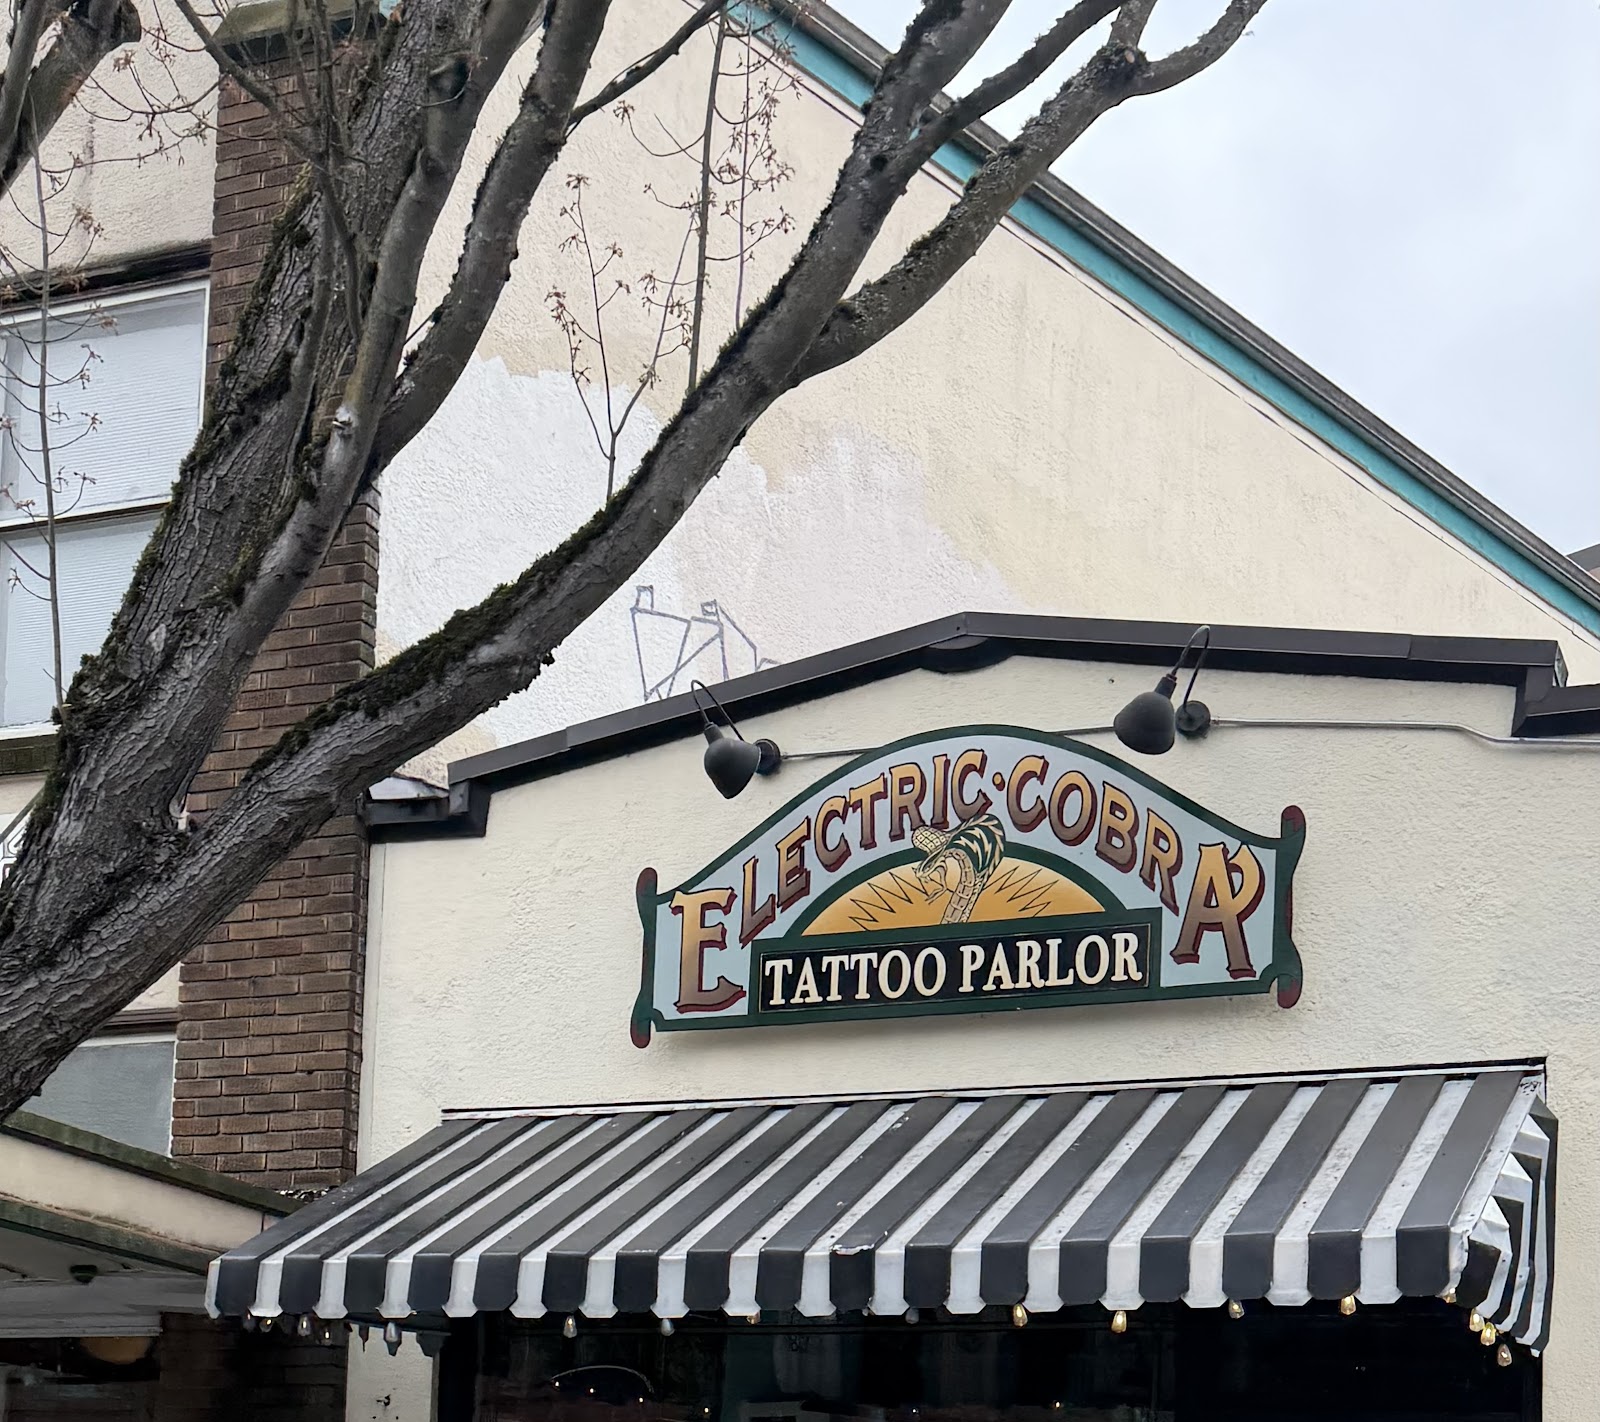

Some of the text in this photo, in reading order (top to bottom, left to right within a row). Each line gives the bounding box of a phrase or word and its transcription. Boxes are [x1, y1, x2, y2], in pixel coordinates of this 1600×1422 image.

[670, 748, 1266, 1014] ELECTRIC COBRA
[764, 932, 1143, 1006] TATTOO PARLOR
